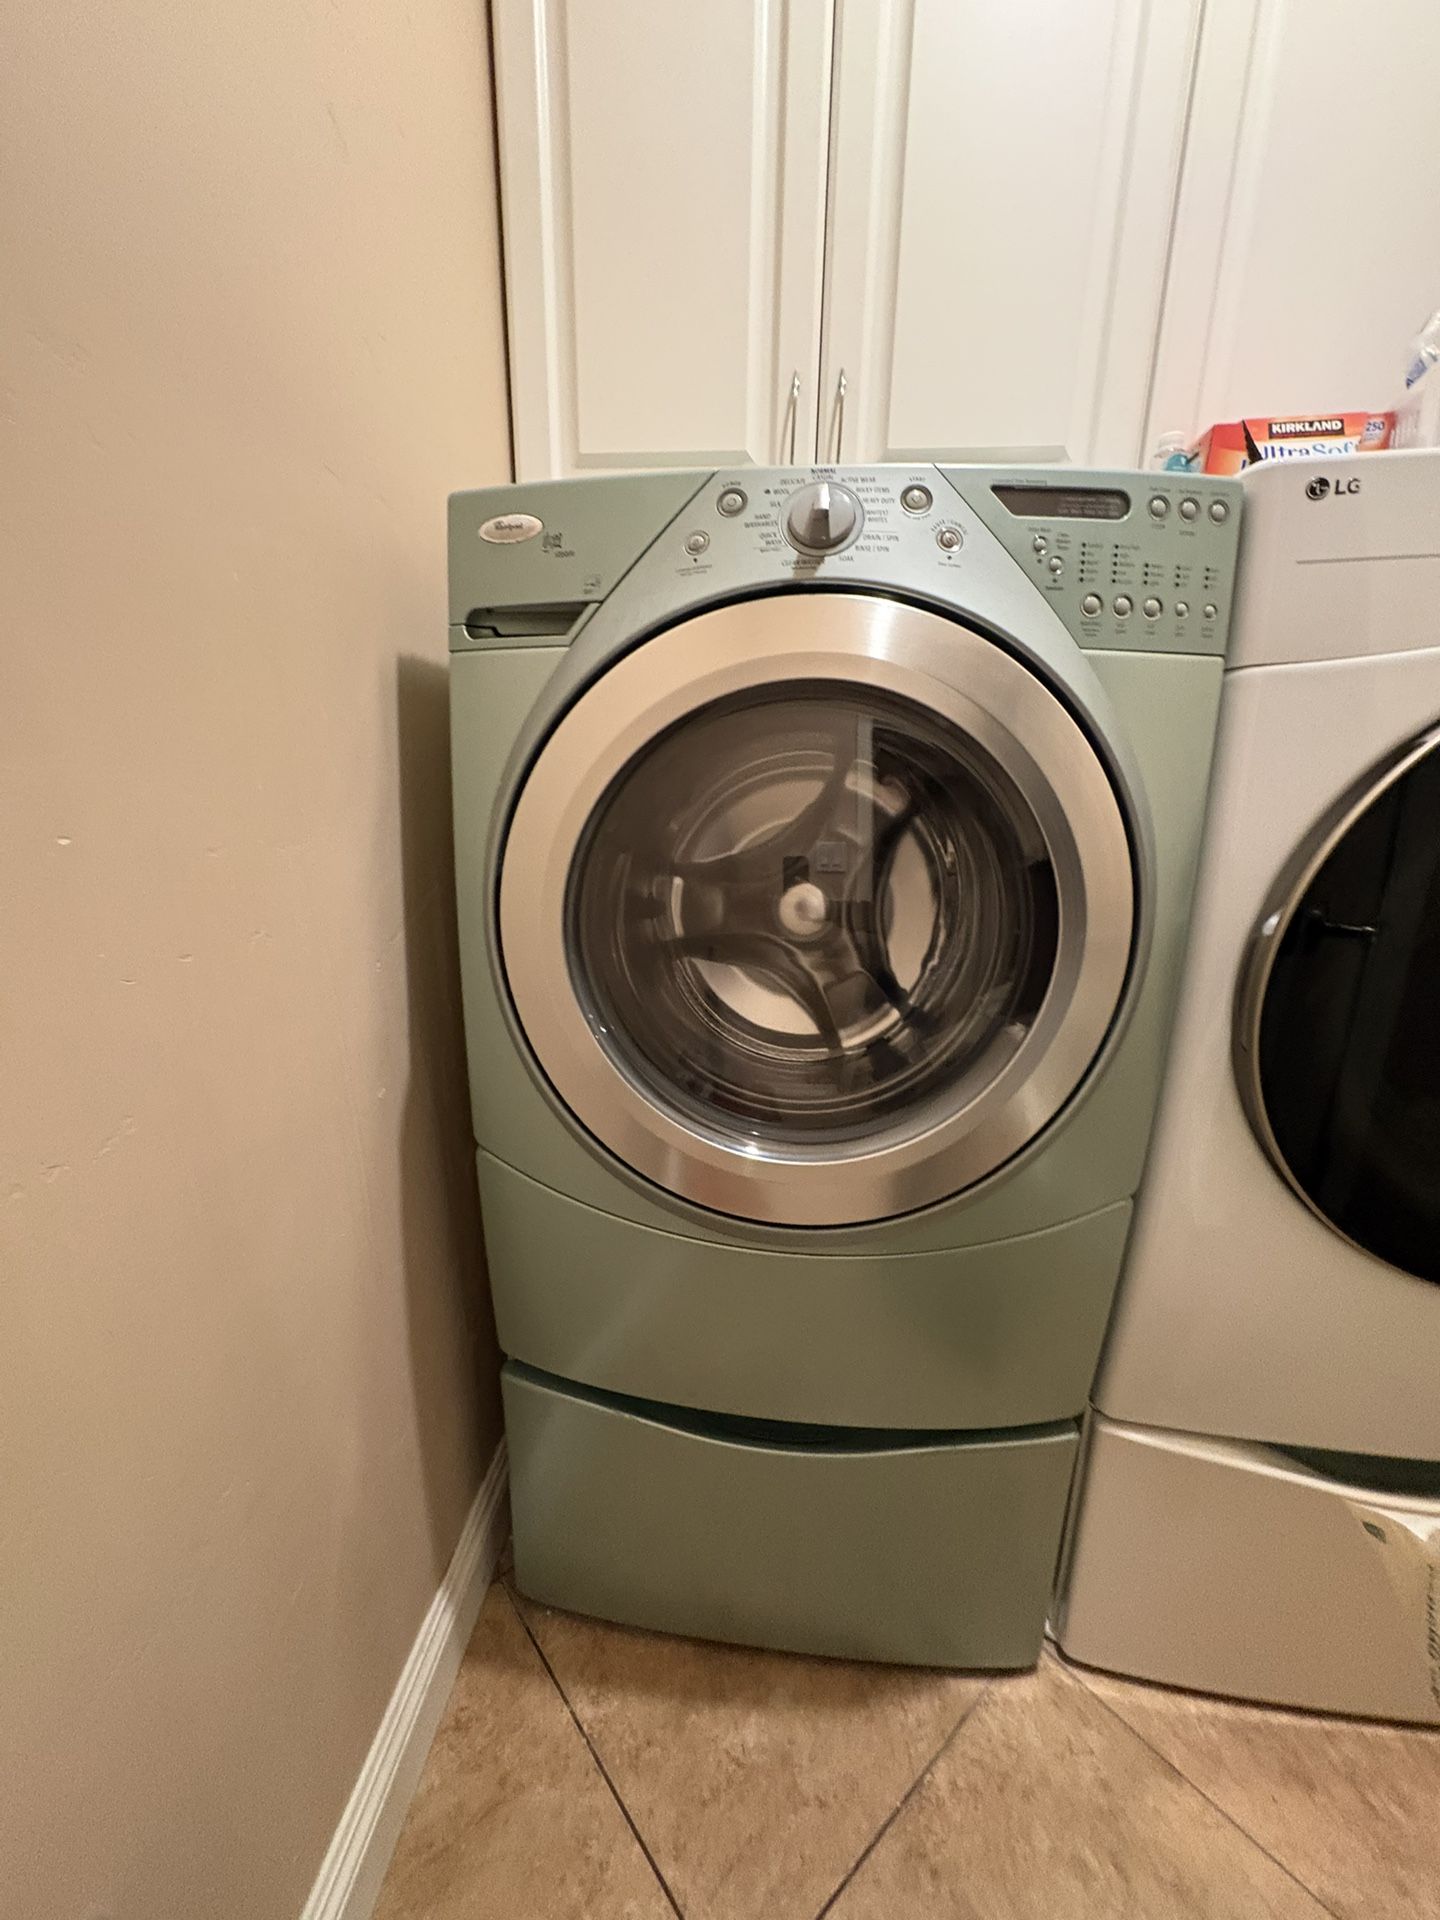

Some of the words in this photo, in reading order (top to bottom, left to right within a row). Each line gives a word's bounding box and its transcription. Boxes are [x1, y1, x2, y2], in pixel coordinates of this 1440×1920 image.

[1271, 420, 1343, 434] KIRKLAND
[1365, 421, 1385, 432] 250
[1334, 479, 1361, 495] LG
